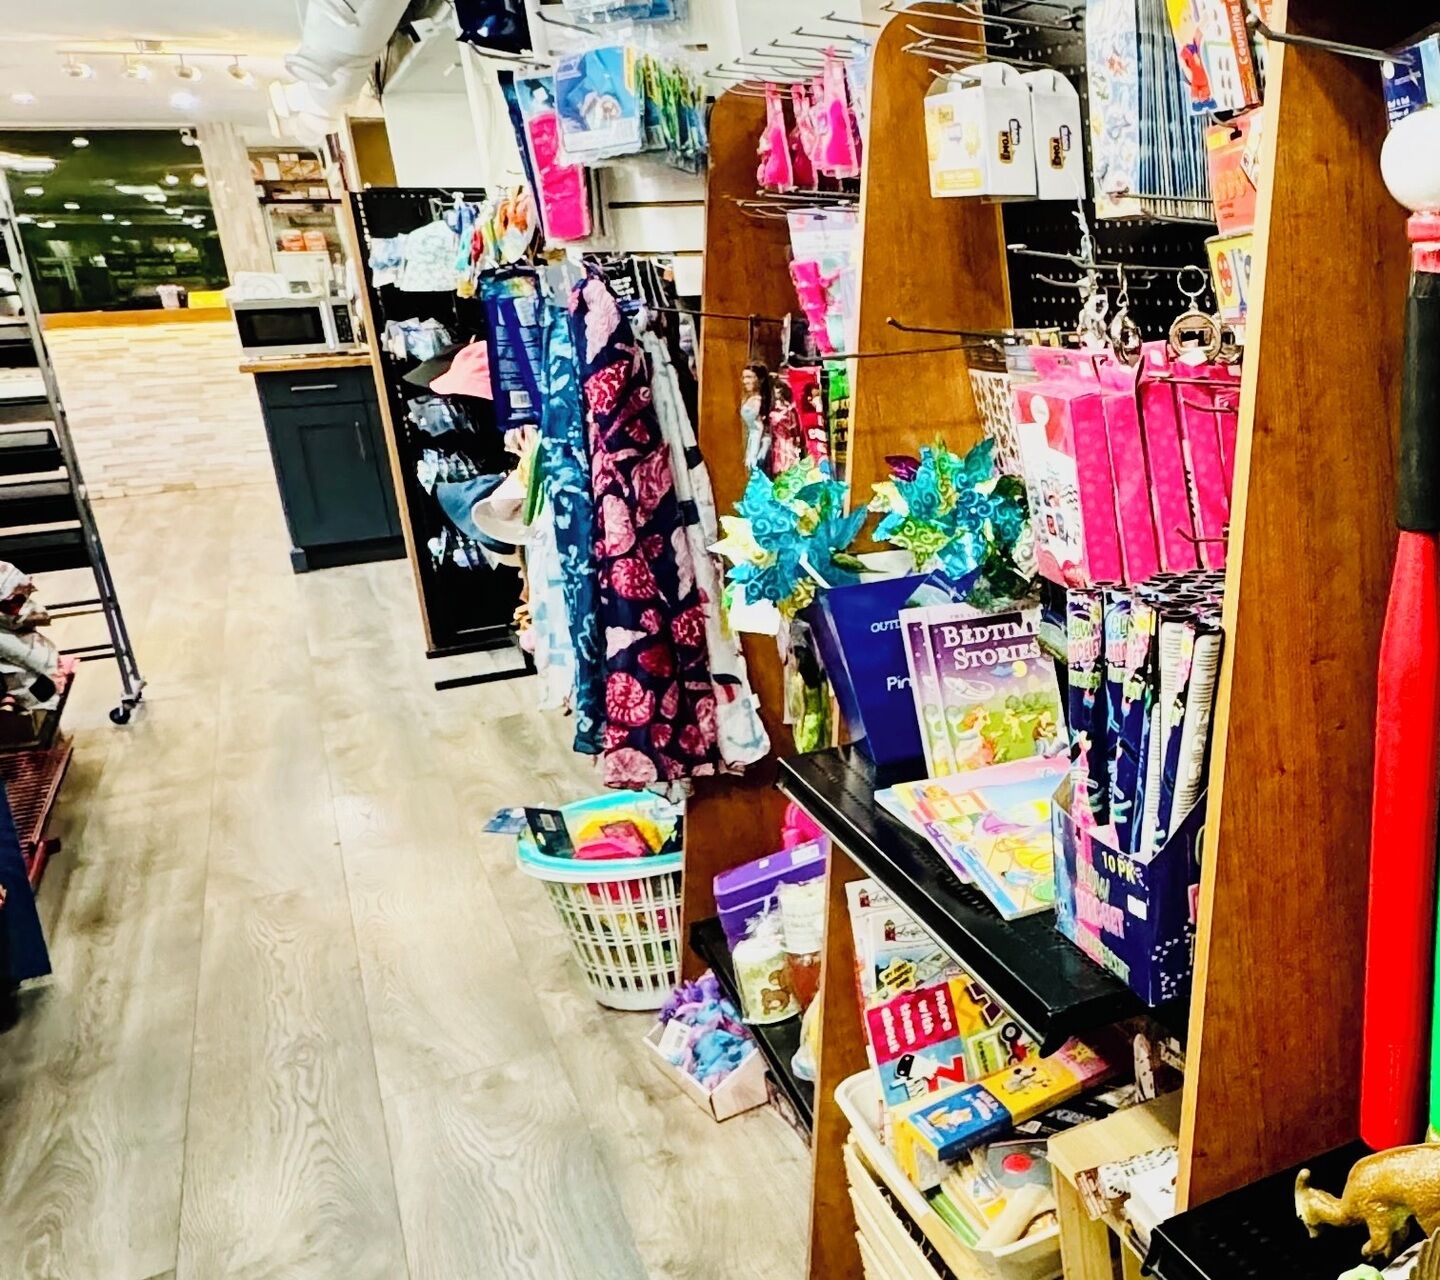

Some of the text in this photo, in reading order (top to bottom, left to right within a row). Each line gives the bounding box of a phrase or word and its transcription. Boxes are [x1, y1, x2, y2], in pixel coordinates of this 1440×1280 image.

[953, 640, 1042, 670] STORIES
[1102, 851, 1137, 885] 10 PK
[881, 1006, 901, 1055] about
[901, 1002, 917, 1047] them
[918, 998, 935, 1037] with
[935, 989, 953, 1033] more
